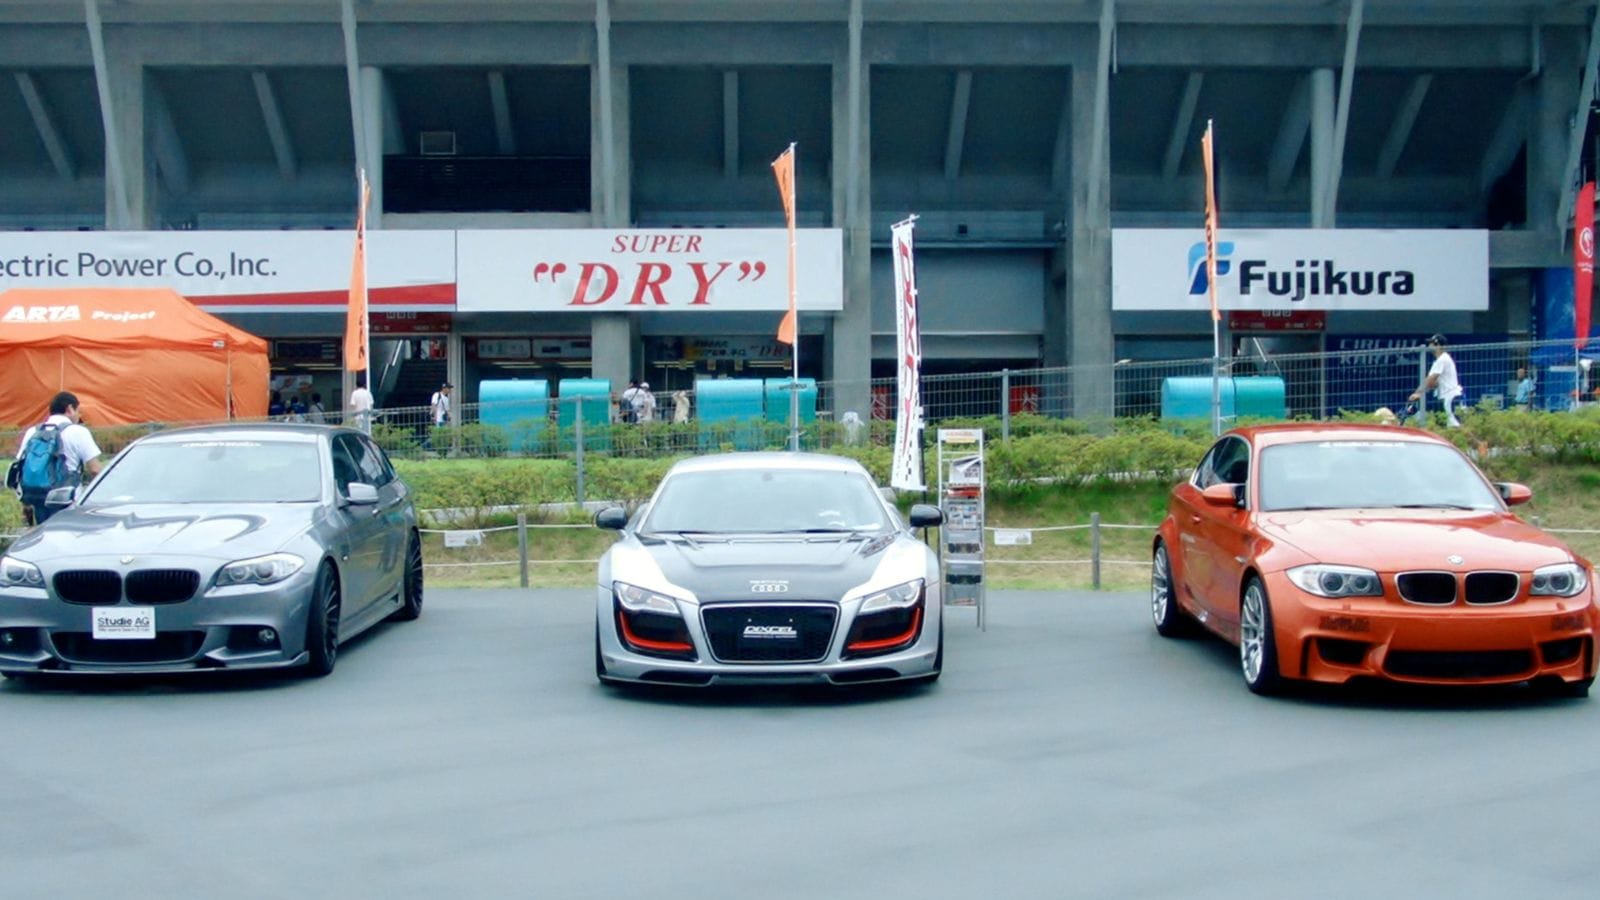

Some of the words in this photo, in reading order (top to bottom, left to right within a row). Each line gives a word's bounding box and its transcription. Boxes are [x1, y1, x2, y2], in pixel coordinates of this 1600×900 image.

[611, 234, 702, 253] SUPER
[78, 252, 167, 277] Power
[1239, 260, 1415, 302] Fujikura
[2, 304, 81, 323] ARTA
[91, 310, 156, 323] Project
[97, 616, 133, 626] Studie
[135, 616, 150, 626] AG
